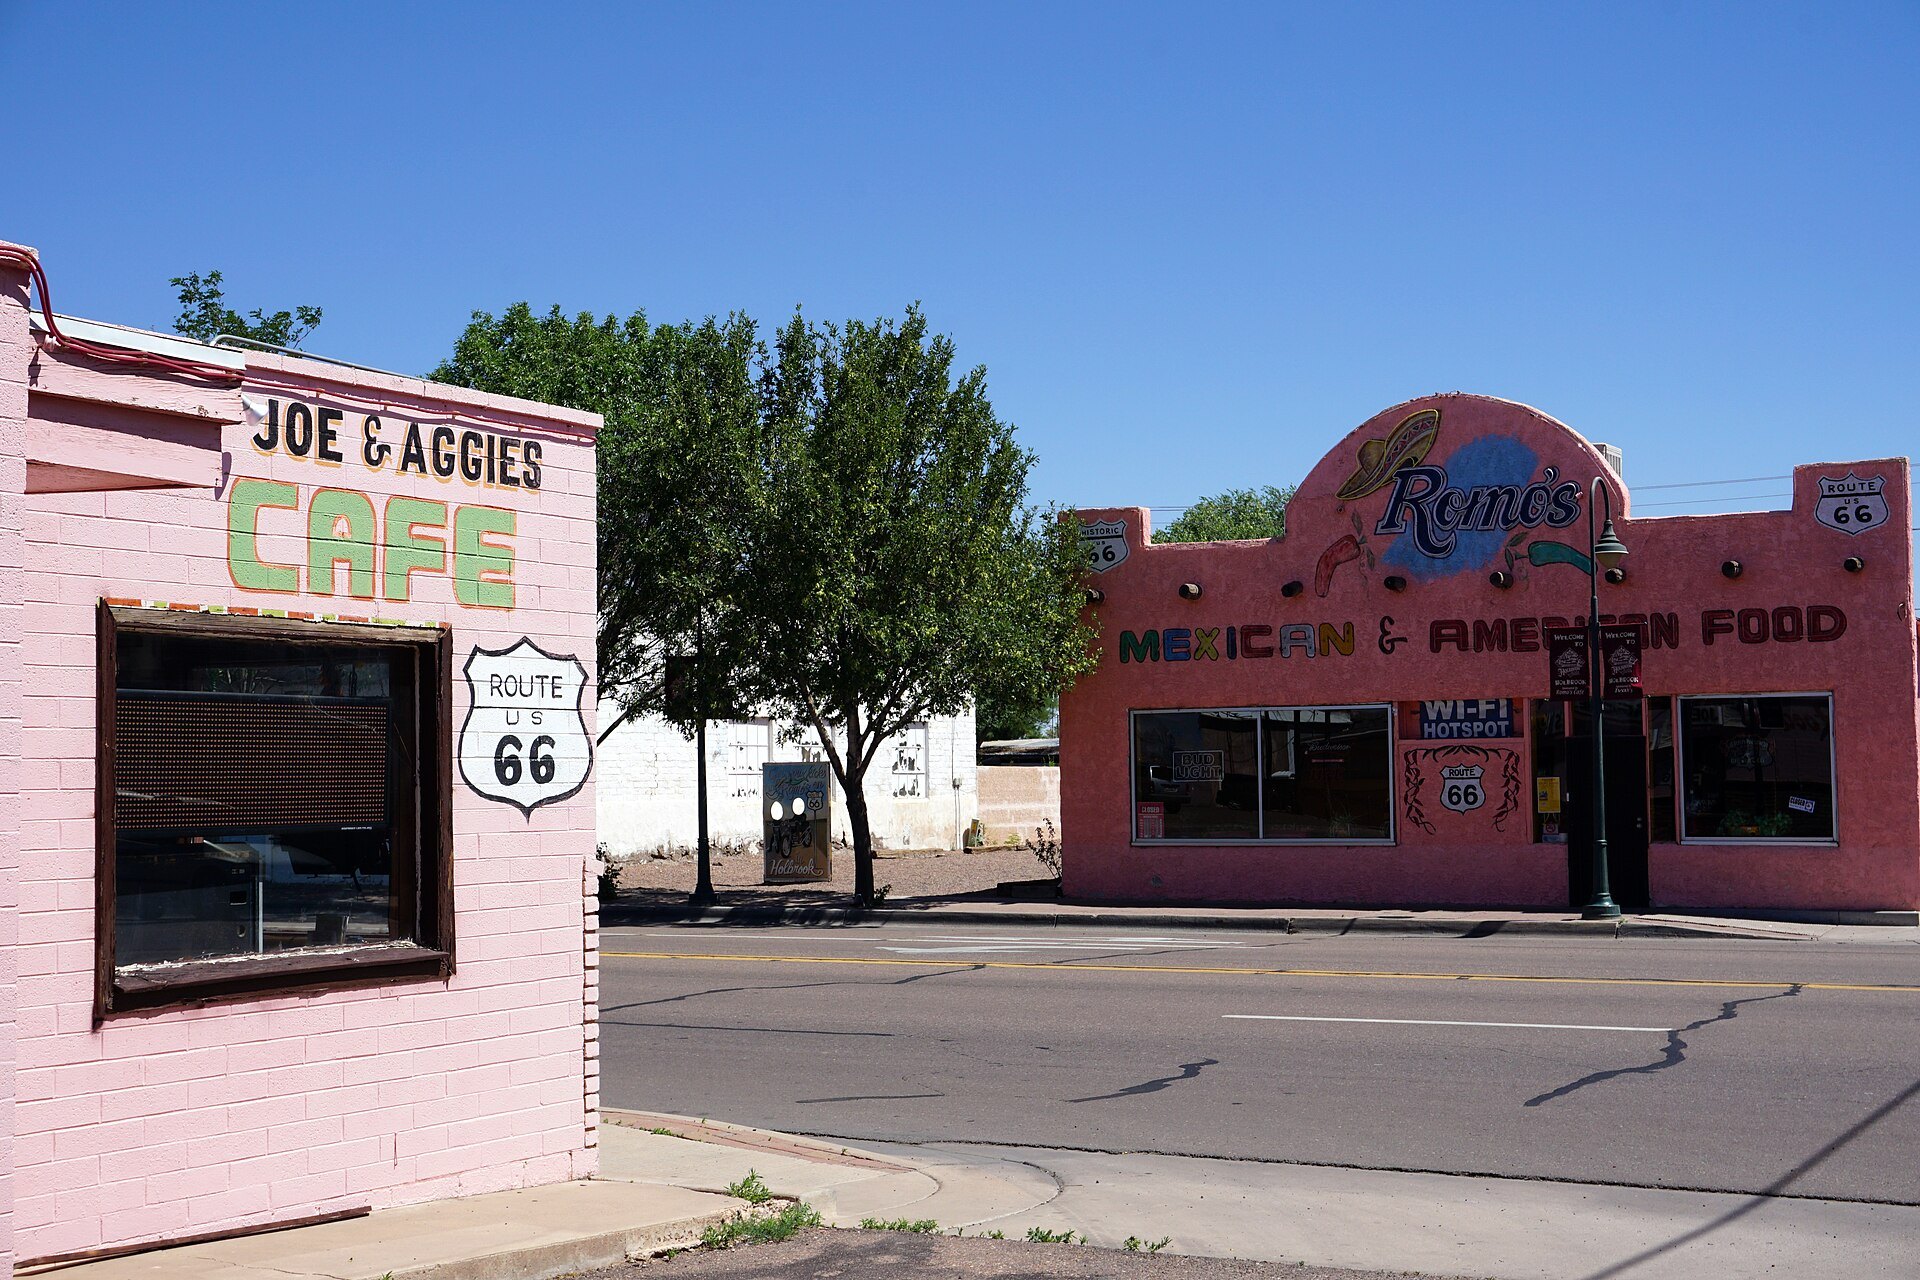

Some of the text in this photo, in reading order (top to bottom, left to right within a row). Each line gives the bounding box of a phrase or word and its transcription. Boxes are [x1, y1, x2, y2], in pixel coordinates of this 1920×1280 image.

[252, 398, 543, 491] JOE & AGGIES
[1828, 482, 1876, 493] ROUTE
[1374, 465, 1582, 560] Romo's
[1834, 504, 1873, 524] 66
[1081, 527, 1119, 536] HISTORIC
[227, 475, 518, 611] CAFE
[1119, 605, 1848, 663] MEXICAN & AMEN FOOD
[490, 673, 563, 699] ROUTE
[1424, 700, 1508, 720] WI-FI
[1423, 721, 1510, 739] HOTSPOT
[494, 735, 556, 787] 66
[1182, 753, 1215, 766] BUD
[1175, 765, 1222, 779] LIGHT
[1448, 768, 1476, 777] ROUTE
[808, 800, 820, 809] 66
[1447, 784, 1479, 806] 66
[770, 858, 824, 876] Holbrook
